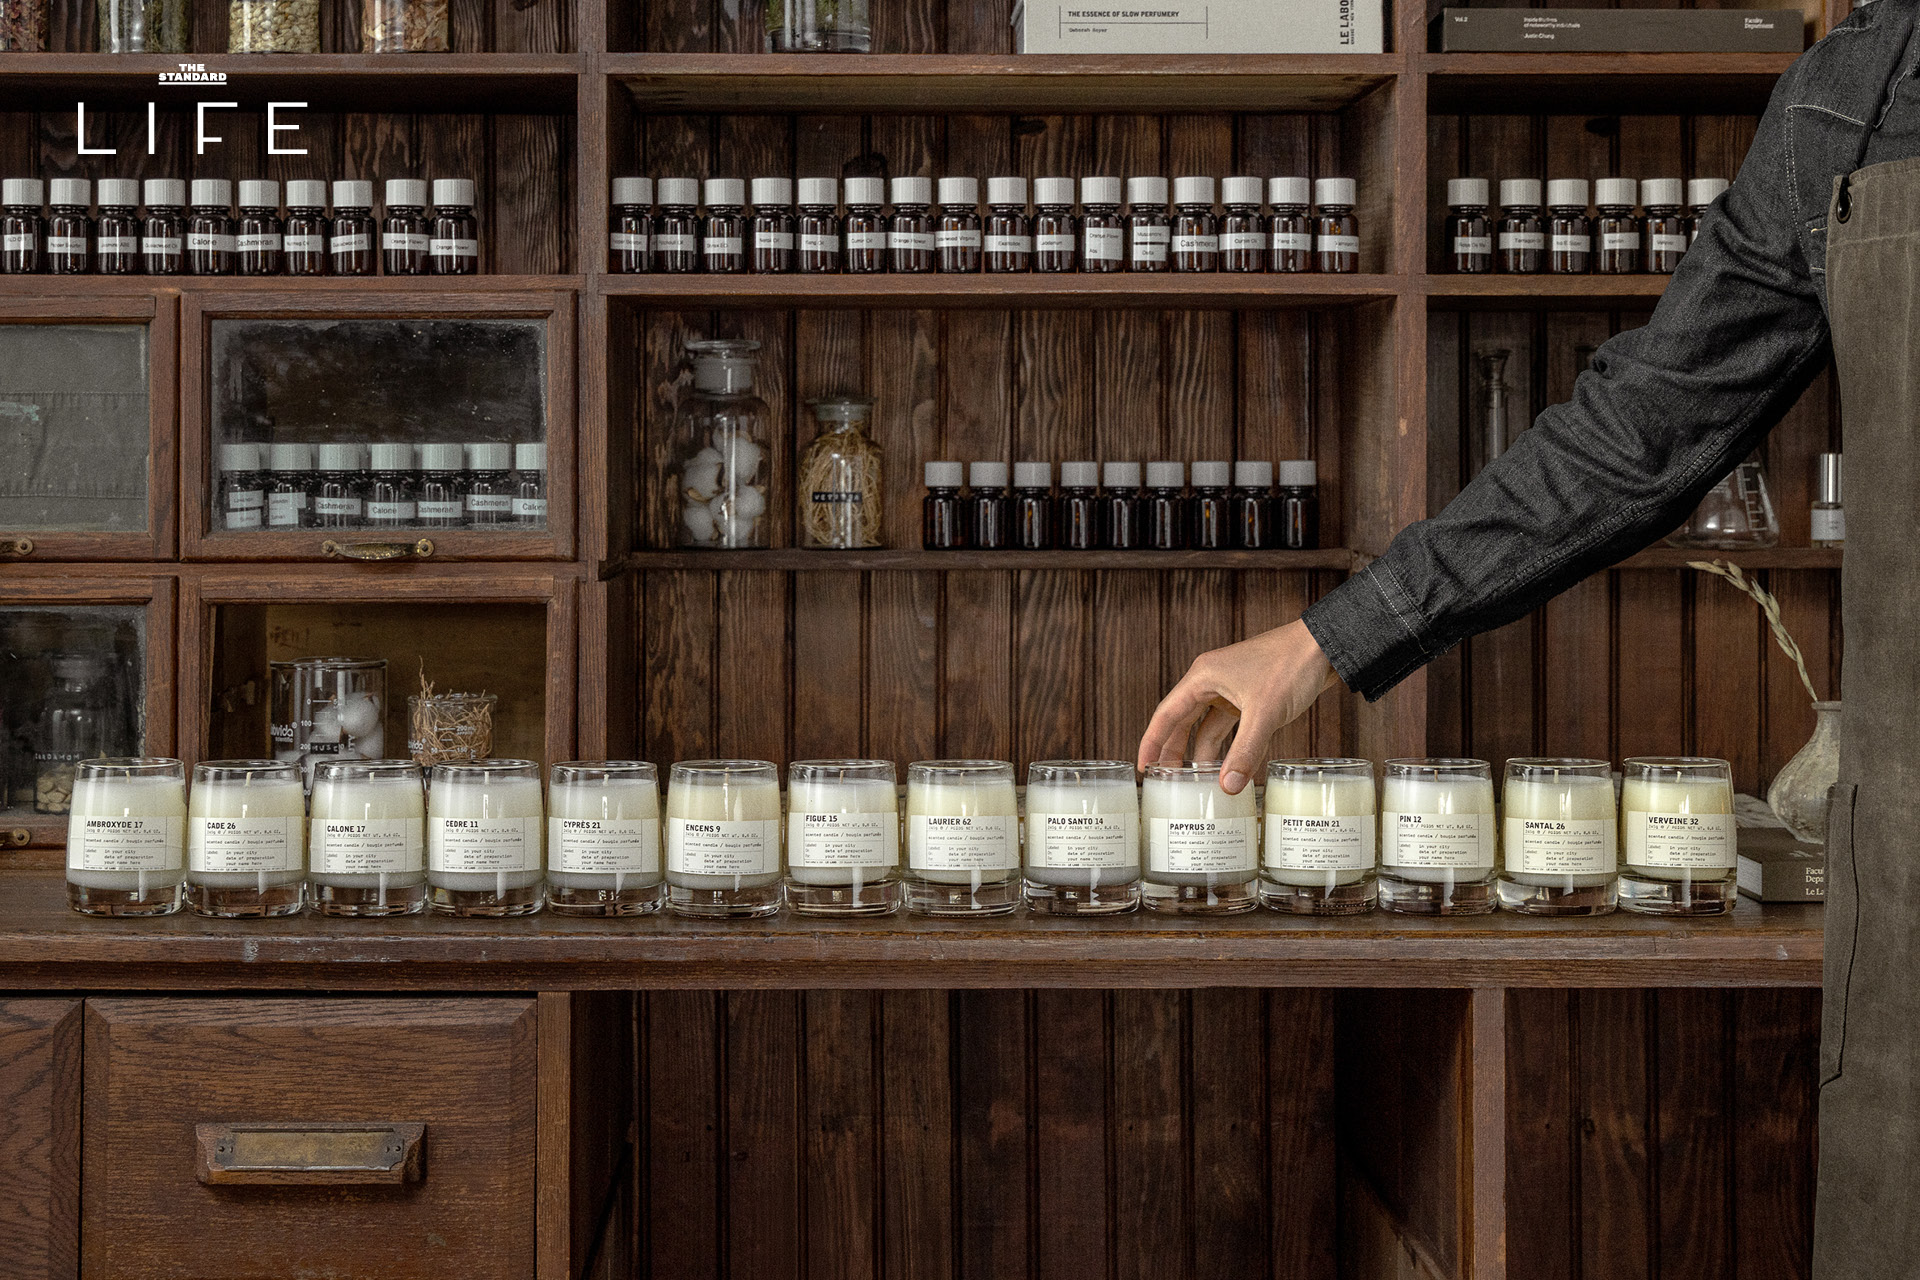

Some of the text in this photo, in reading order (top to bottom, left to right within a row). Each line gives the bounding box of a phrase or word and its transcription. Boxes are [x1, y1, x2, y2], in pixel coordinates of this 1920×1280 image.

[1340, 0, 1349, 45] LE LABO
[372, 506, 397, 514] Calone
[564, 820, 590, 828] CYPRÈS
[686, 824, 714, 832] ENCENS
